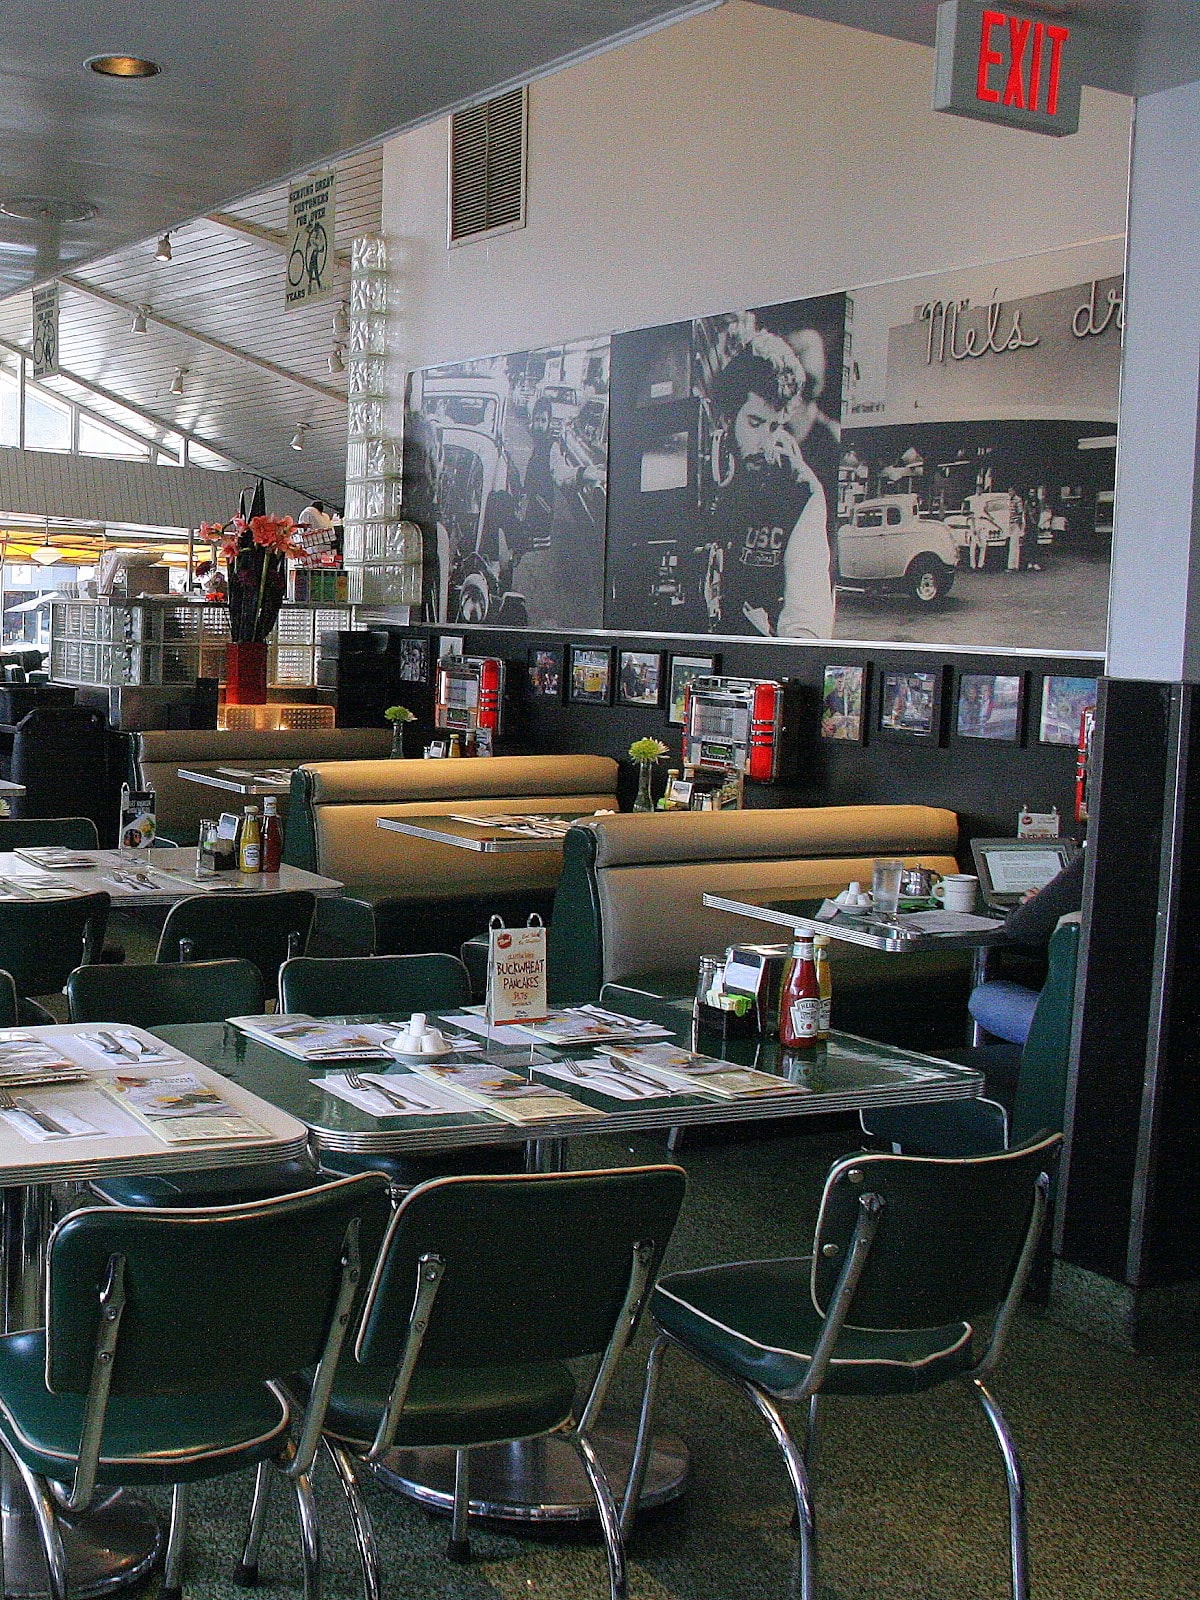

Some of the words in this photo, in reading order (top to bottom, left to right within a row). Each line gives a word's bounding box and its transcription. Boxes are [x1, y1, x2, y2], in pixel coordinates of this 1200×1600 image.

[976, 10, 1070, 115] EXIT
[289, 184, 314, 203] SERVING
[315, 175, 335, 193] GREAT
[293, 191, 329, 215] CUSTOMERS
[296, 214, 308, 228] FOR
[311, 207, 326, 221] OVER
[286, 289, 306, 302] YEARS
[745, 526, 784, 549] USC
[497, 959, 545, 975] BUCKWHEAT
[503, 976, 539, 989] PANCAKES
